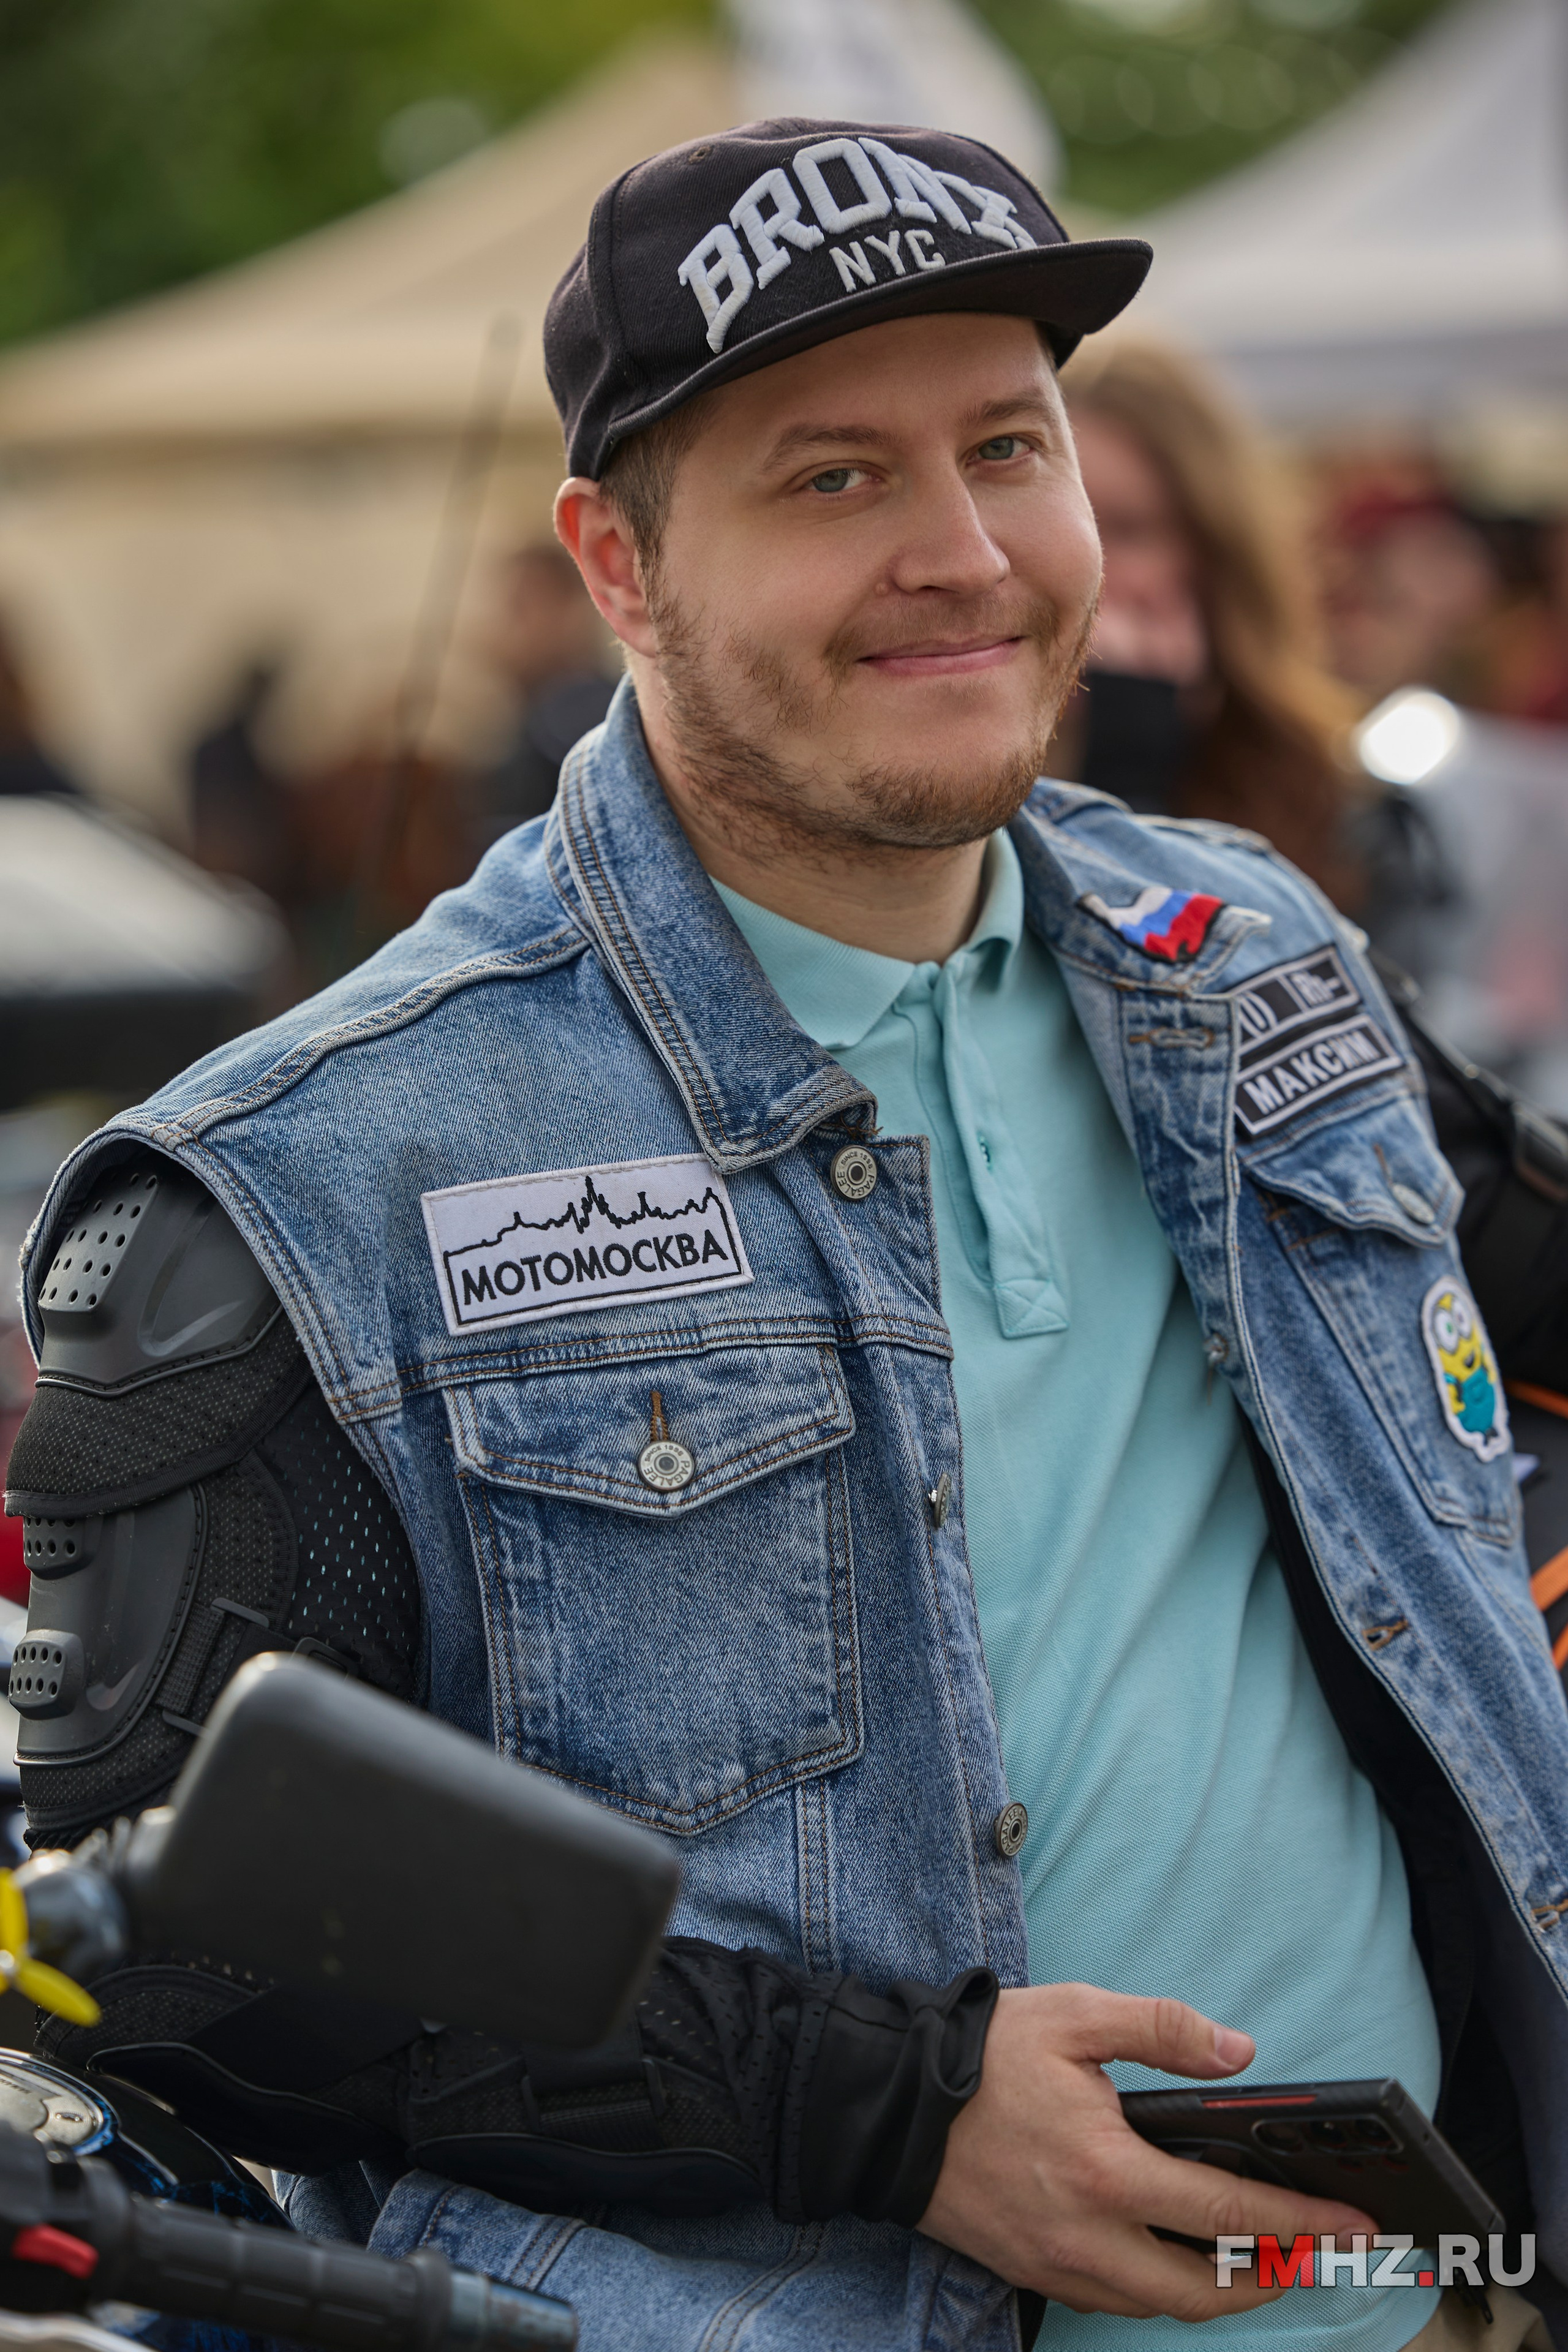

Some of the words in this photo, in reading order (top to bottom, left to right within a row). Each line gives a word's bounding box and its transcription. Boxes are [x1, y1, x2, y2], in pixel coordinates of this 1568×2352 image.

[678, 137, 1037, 353] BRONX
[829, 229, 946, 293] NYC
[1242, 1031, 1380, 1115] МАКСИМ
[841, 1151, 858, 1166] SINCE
[461, 1229, 728, 1306] МОТОМОСКВА
[645, 1445, 662, 1462] SINCE
